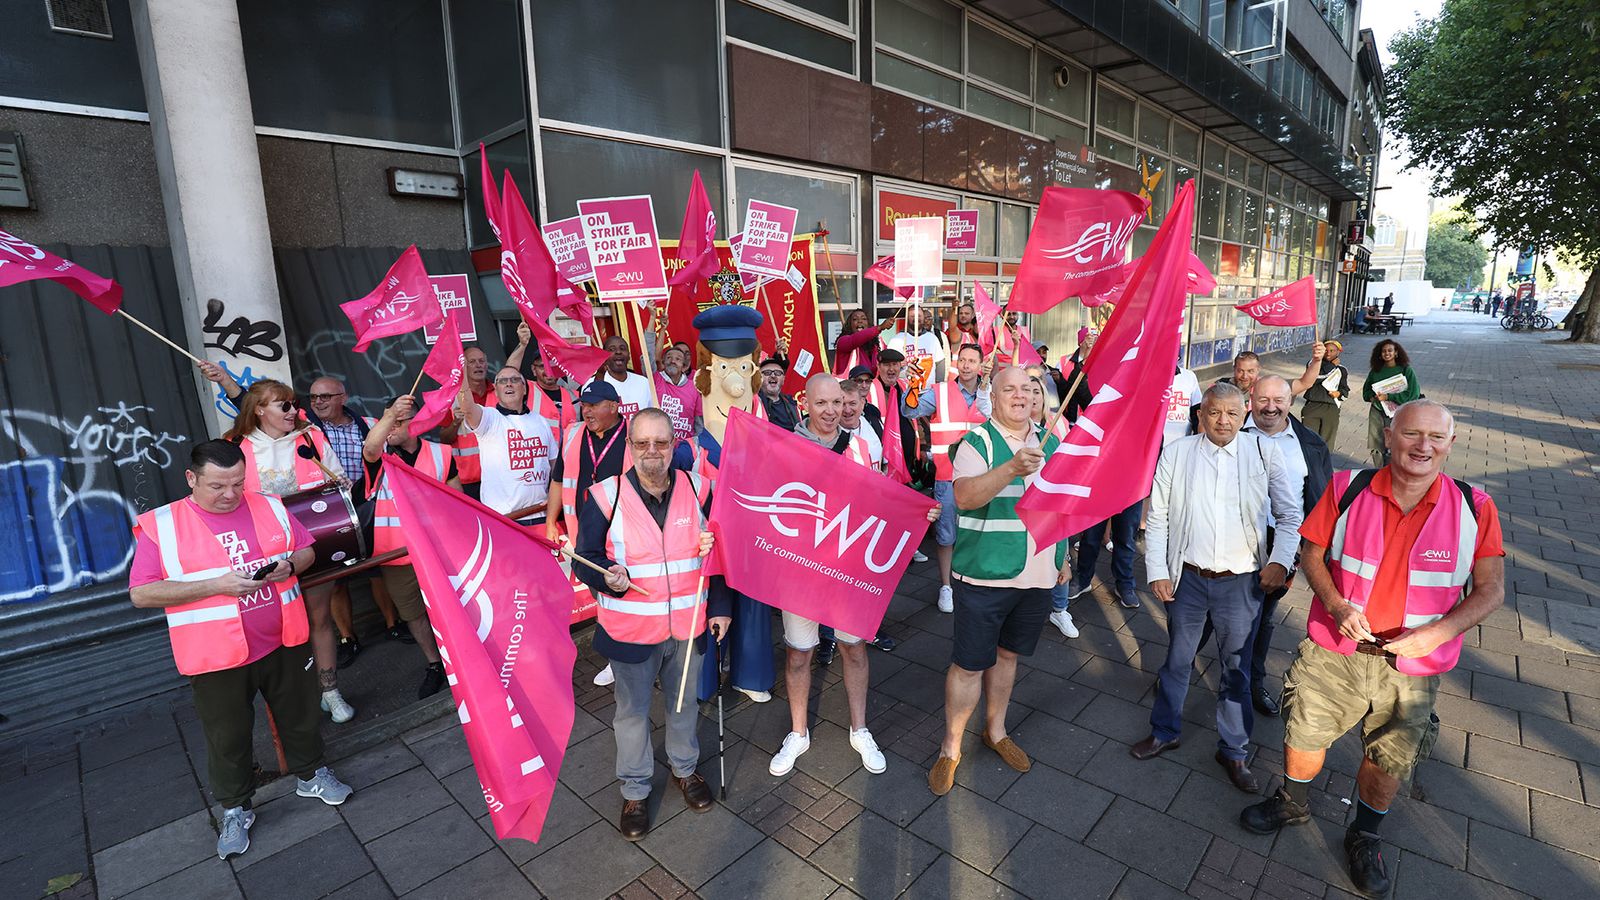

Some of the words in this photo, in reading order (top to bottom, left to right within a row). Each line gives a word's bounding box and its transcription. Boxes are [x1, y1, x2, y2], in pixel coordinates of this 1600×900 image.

[1056, 148, 1067, 158] Upper
[1055, 159, 1077, 171] Commercial
[1055, 170, 1062, 181] To
[1063, 171, 1072, 183] Let
[587, 215, 605, 227] ON
[751, 211, 764, 220] ON
[749, 220, 777, 231] STRIKE
[548, 231, 560, 240] ON
[591, 225, 630, 239] STRIKE
[748, 228, 765, 238] FOR
[766, 231, 785, 241] FAIR
[551, 234, 576, 248] STRIKE
[554, 246, 568, 255] FOR
[570, 239, 587, 251] FAIR
[594, 240, 618, 251] FOR
[620, 236, 647, 248] FAIR
[747, 237, 764, 246] PAY
[557, 252, 571, 262] PAY
[598, 251, 620, 263] PAY
[750, 253, 774, 264] CWU
[567, 262, 588, 273] CWU
[610, 271, 644, 283] CWU
[444, 299, 463, 308] FAIR
[617, 403, 638, 414] RIKE
[508, 431, 521, 440] ON
[509, 437, 540, 449] STRIKE
[511, 450, 531, 458] FOR
[511, 458, 532, 469] PAY
[729, 482, 911, 574] CWU
[221, 533, 234, 545] IS
[1418, 549, 1450, 559] CWU
[754, 535, 773, 552] The
[773, 546, 854, 585] communications
[854, 580, 883, 596] union
[238, 586, 272, 607] WU
